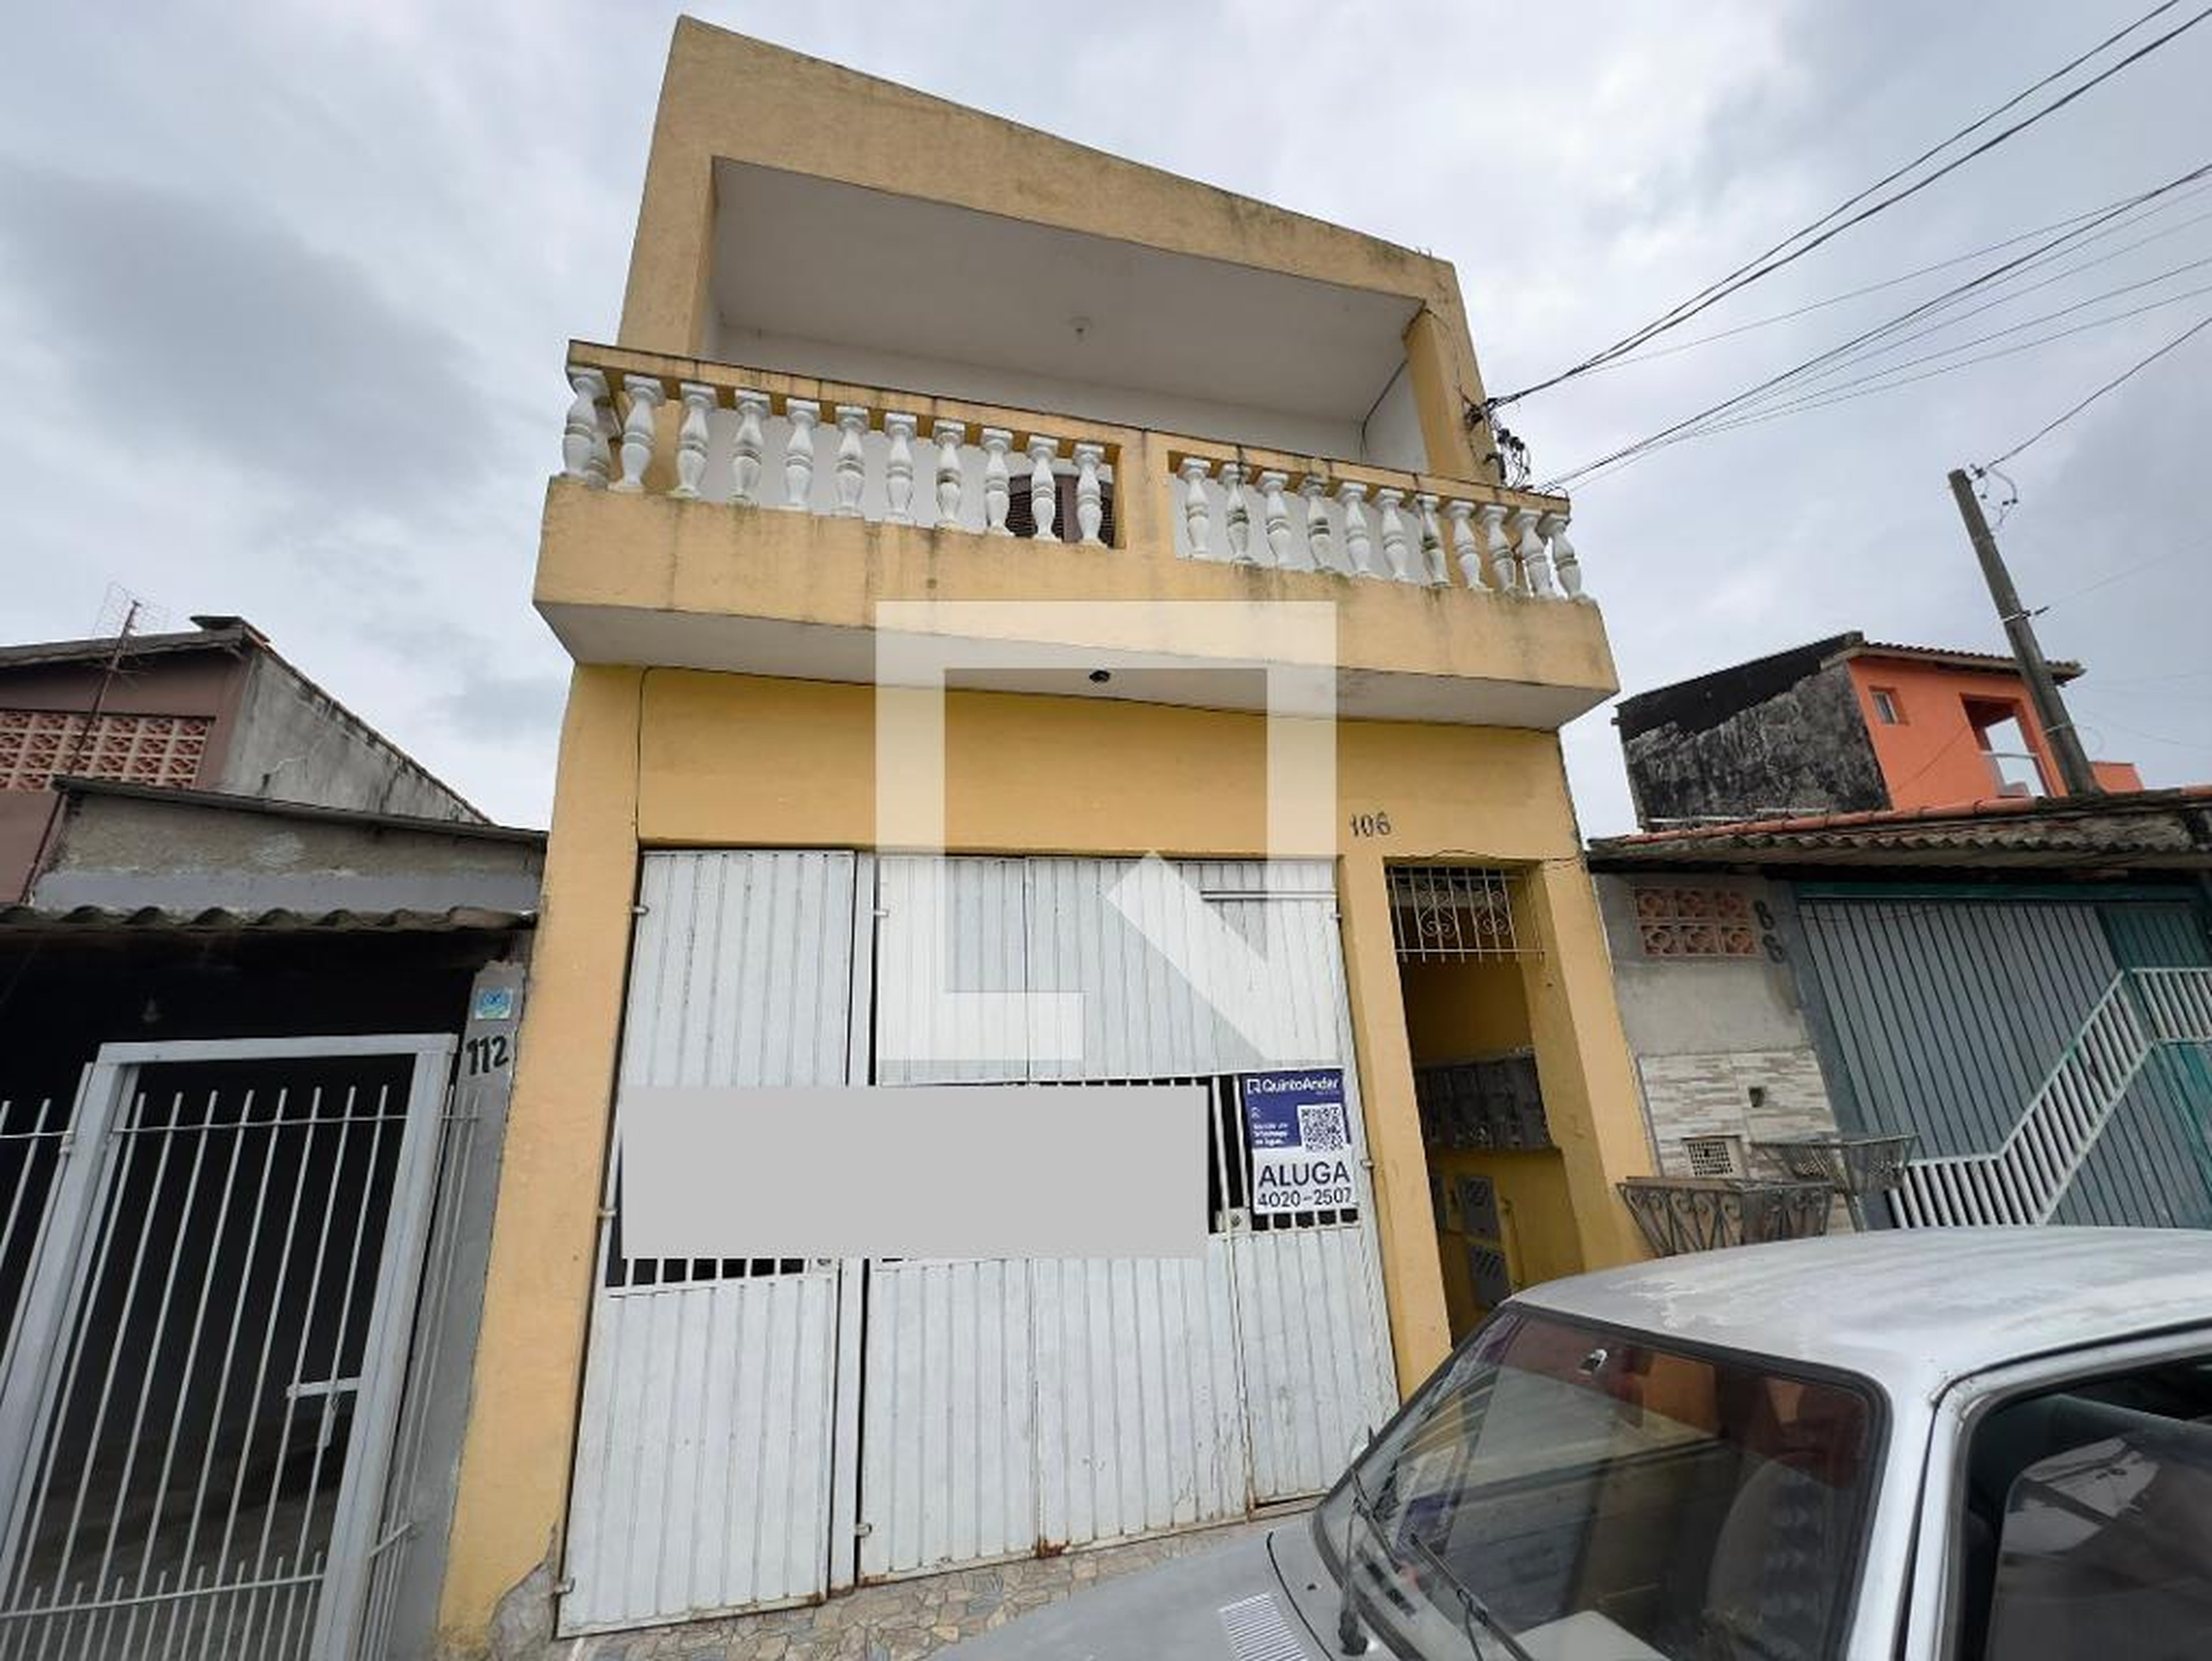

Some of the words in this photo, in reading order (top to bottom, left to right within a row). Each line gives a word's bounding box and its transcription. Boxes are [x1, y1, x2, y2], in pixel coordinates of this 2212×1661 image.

[1351, 812, 1391, 837] 106
[467, 1036, 509, 1075] 112
[1259, 1161, 1350, 1187] ALUGA
[1258, 1187, 1351, 1208] 4020-2507
